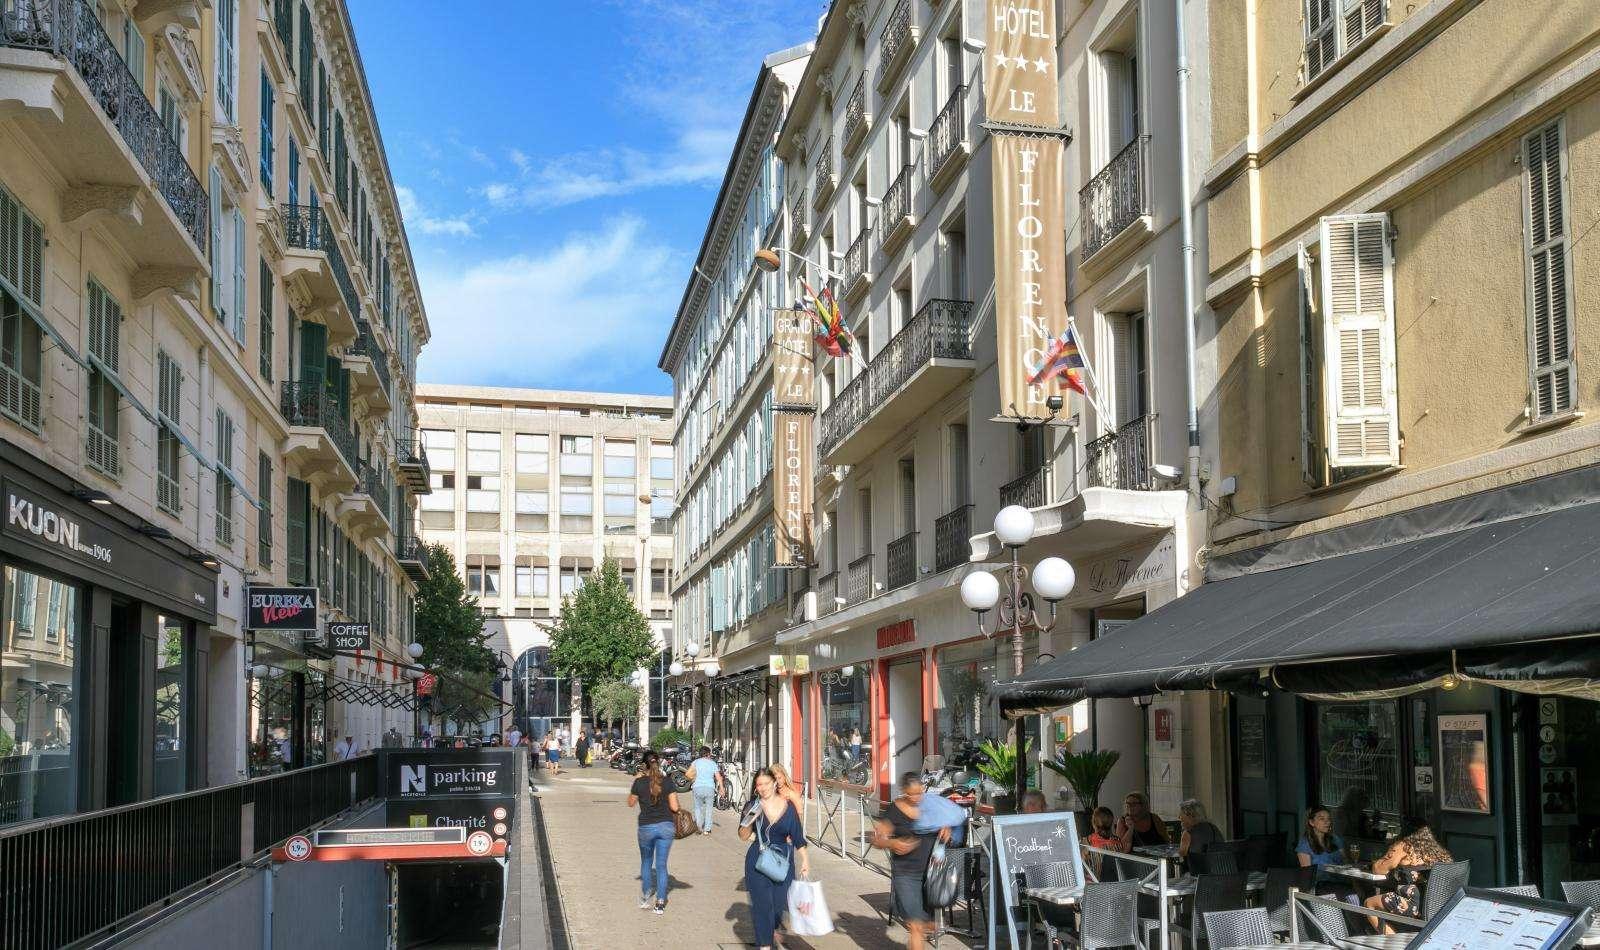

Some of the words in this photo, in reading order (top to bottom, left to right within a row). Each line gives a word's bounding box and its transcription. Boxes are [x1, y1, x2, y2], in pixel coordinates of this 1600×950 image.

[994, 1, 1050, 39] HÔTEL
[1009, 88, 1036, 113] LE
[1017, 150, 1046, 404] FLORENCE
[787, 384, 803, 397] LE
[786, 421, 802, 556] FLORENCE
[9, 494, 80, 551] KUONI
[93, 544, 112, 563] 1906
[251, 594, 316, 609] EUREKA
[262, 603, 303, 624] New
[330, 625, 369, 636] COFFEE
[335, 637, 364, 648] SHOP
[432, 768, 497, 786] parking
[435, 815, 487, 828] Charité
